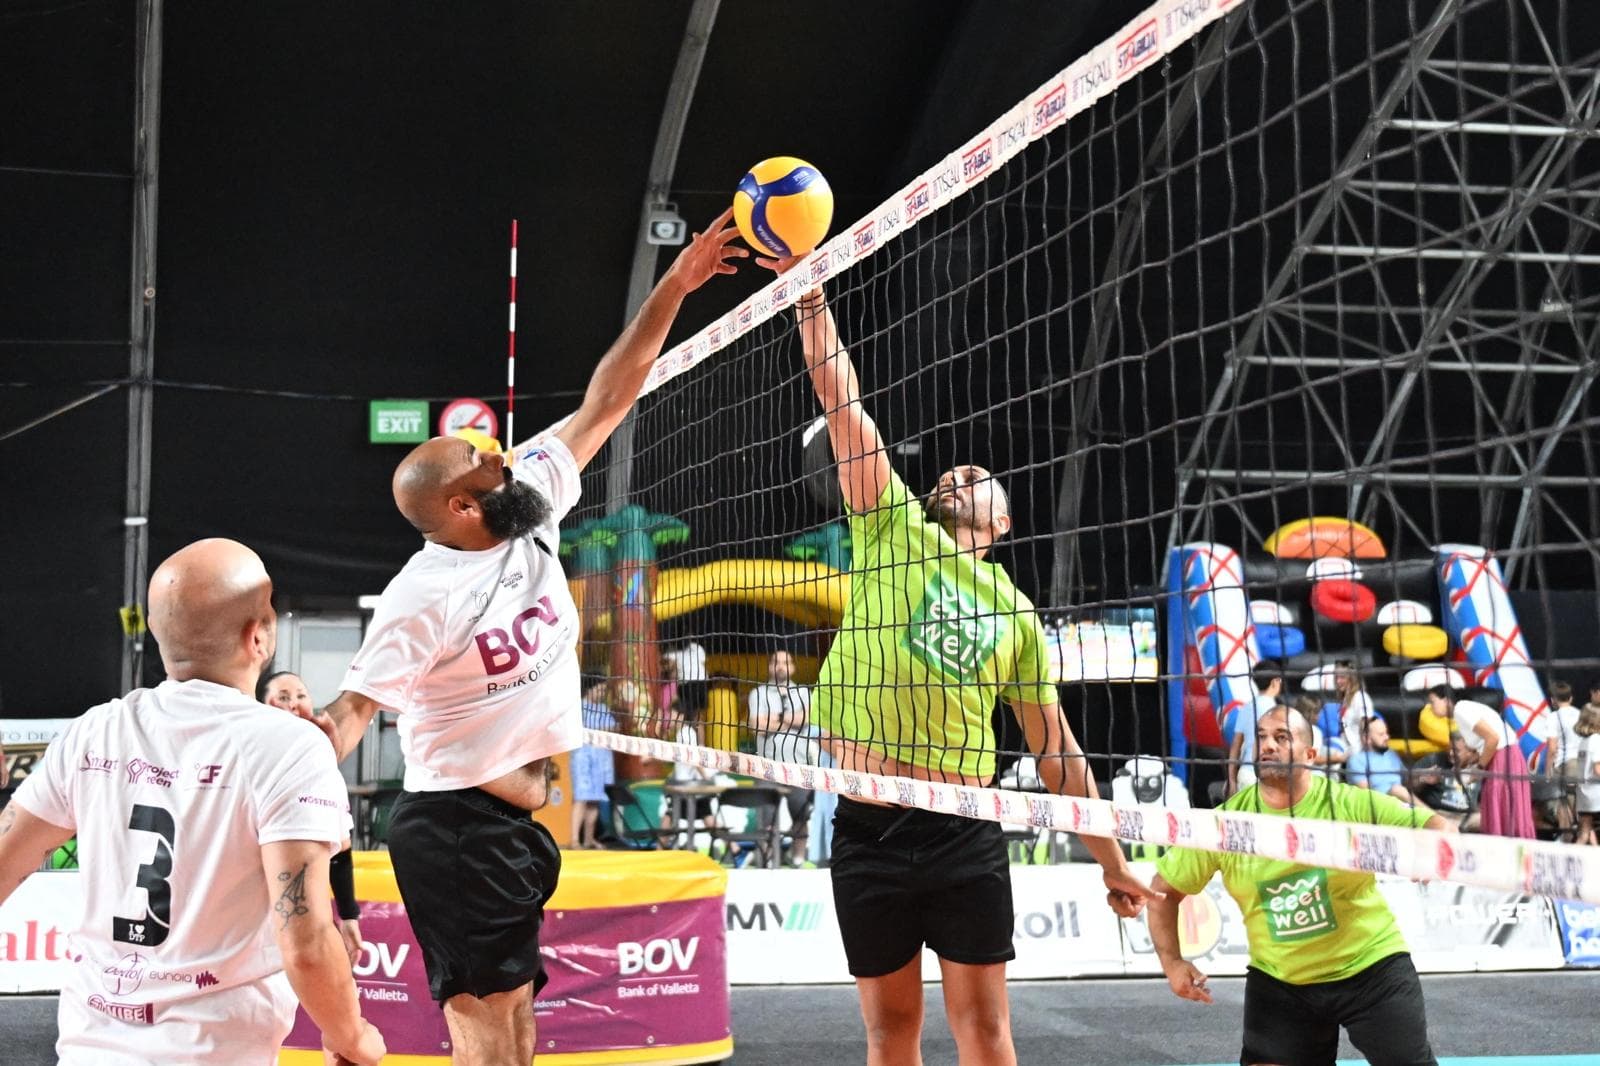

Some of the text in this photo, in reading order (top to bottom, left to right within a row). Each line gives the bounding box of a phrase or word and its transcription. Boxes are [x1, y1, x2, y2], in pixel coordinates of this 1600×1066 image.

[378, 418, 423, 433] EXIT
[113, 803, 175, 947] 3
[1273, 903, 1327, 929] well
[0, 920, 72, 962] alt
[617, 936, 700, 976] BOV
[352, 940, 410, 978] OV
[364, 987, 409, 1002] Valletta
[617, 982, 700, 999] Bank of Valletta
